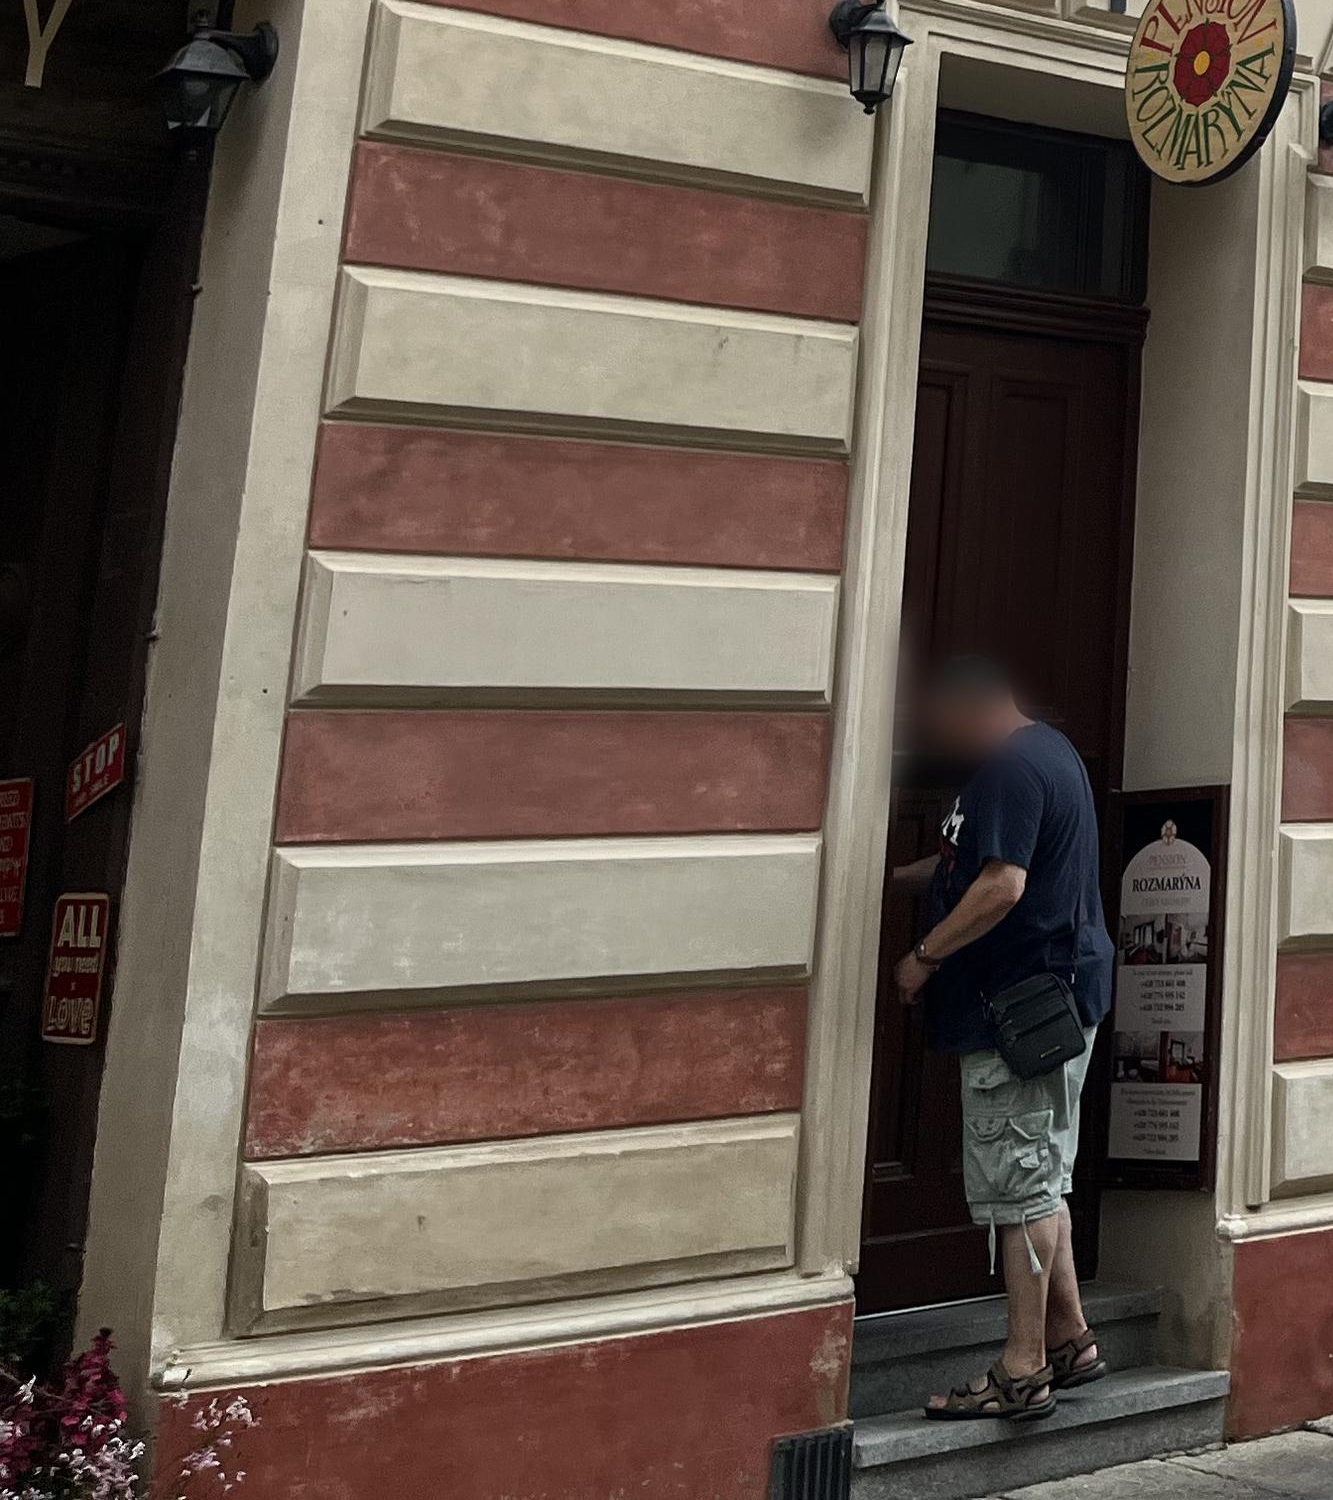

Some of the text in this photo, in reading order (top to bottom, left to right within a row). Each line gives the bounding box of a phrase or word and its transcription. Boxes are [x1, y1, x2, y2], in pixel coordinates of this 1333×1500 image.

[72, 732, 120, 793] STOP
[1131, 872, 1201, 892] ROZMARÝNA
[57, 905, 102, 948] ALL
